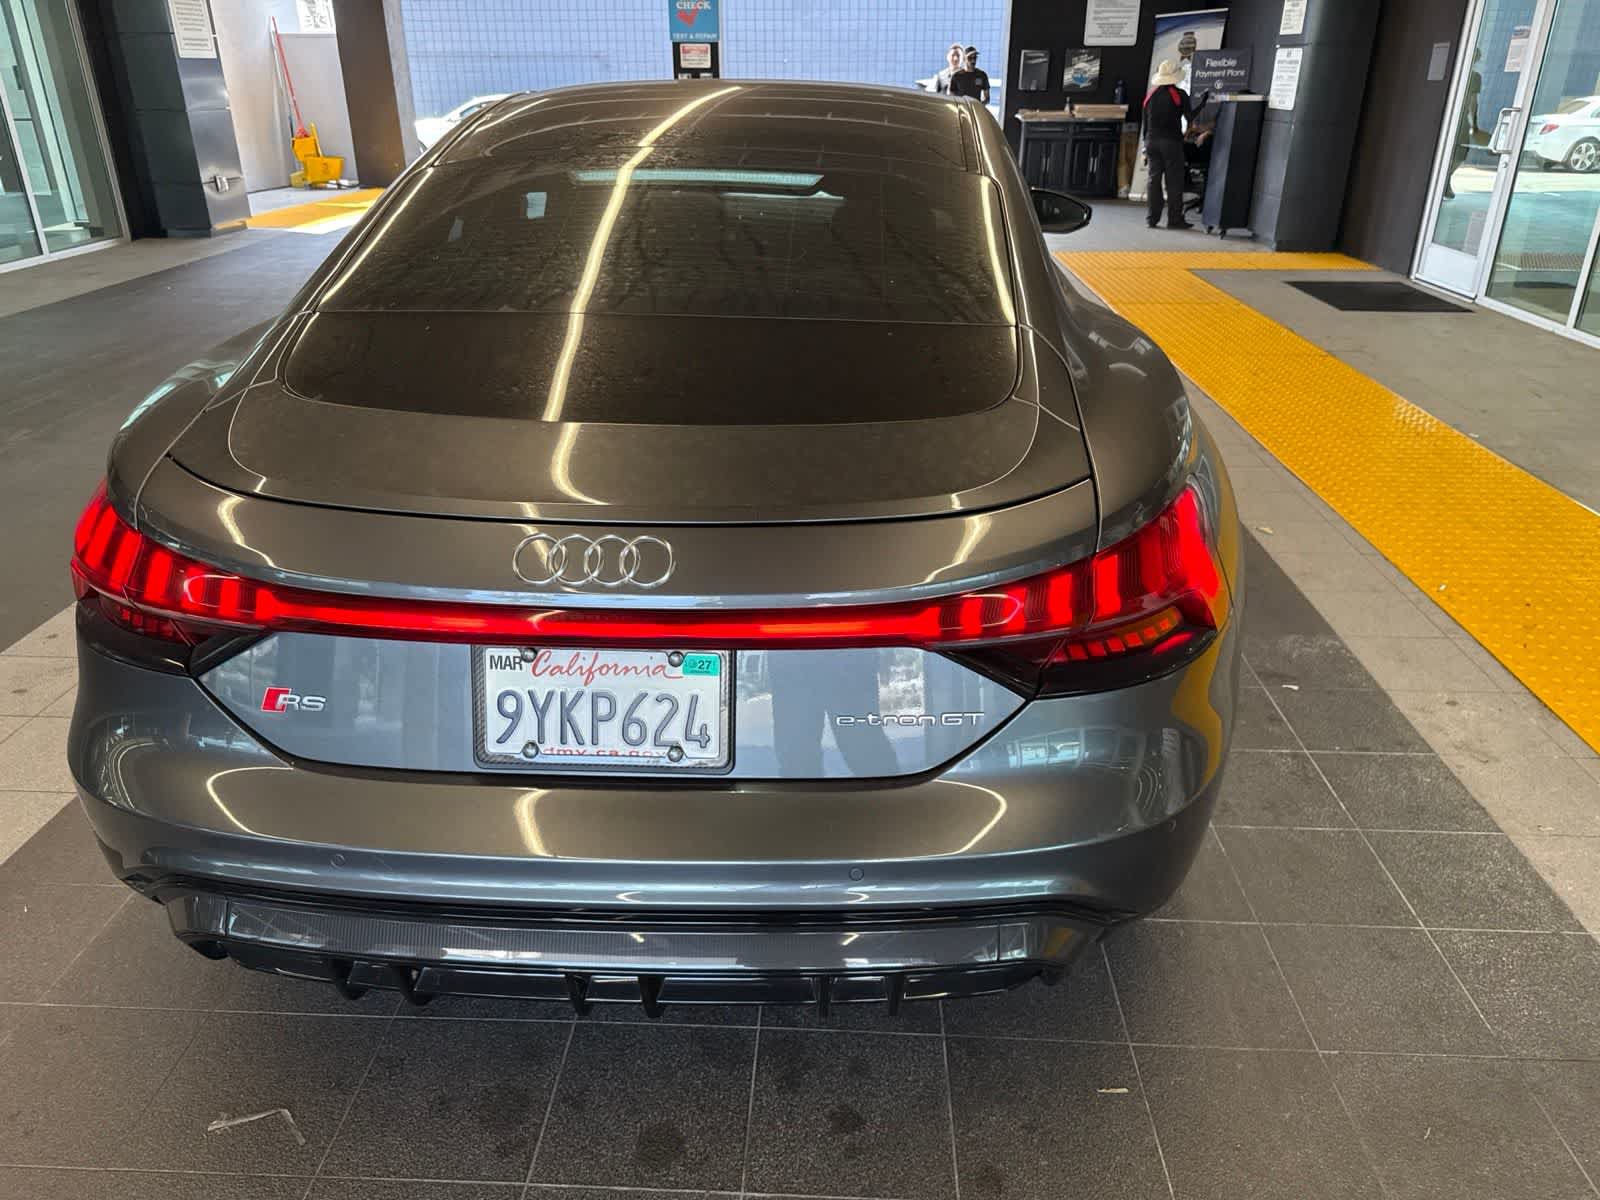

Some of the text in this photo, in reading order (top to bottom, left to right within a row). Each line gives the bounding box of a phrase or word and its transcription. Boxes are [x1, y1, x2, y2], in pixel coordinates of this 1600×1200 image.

[675, 1, 712, 10] CHECK
[1205, 58, 1237, 68] Flexible
[1195, 69, 1246, 79] Payment Plans
[489, 655, 524, 671] MAR
[530, 650, 683, 687] California
[697, 660, 712, 670] 27
[274, 693, 327, 712] RS
[496, 689, 711, 749] 9YKP624
[835, 712, 985, 727] e-tron GT
[543, 747, 666, 757] dmvcagov
